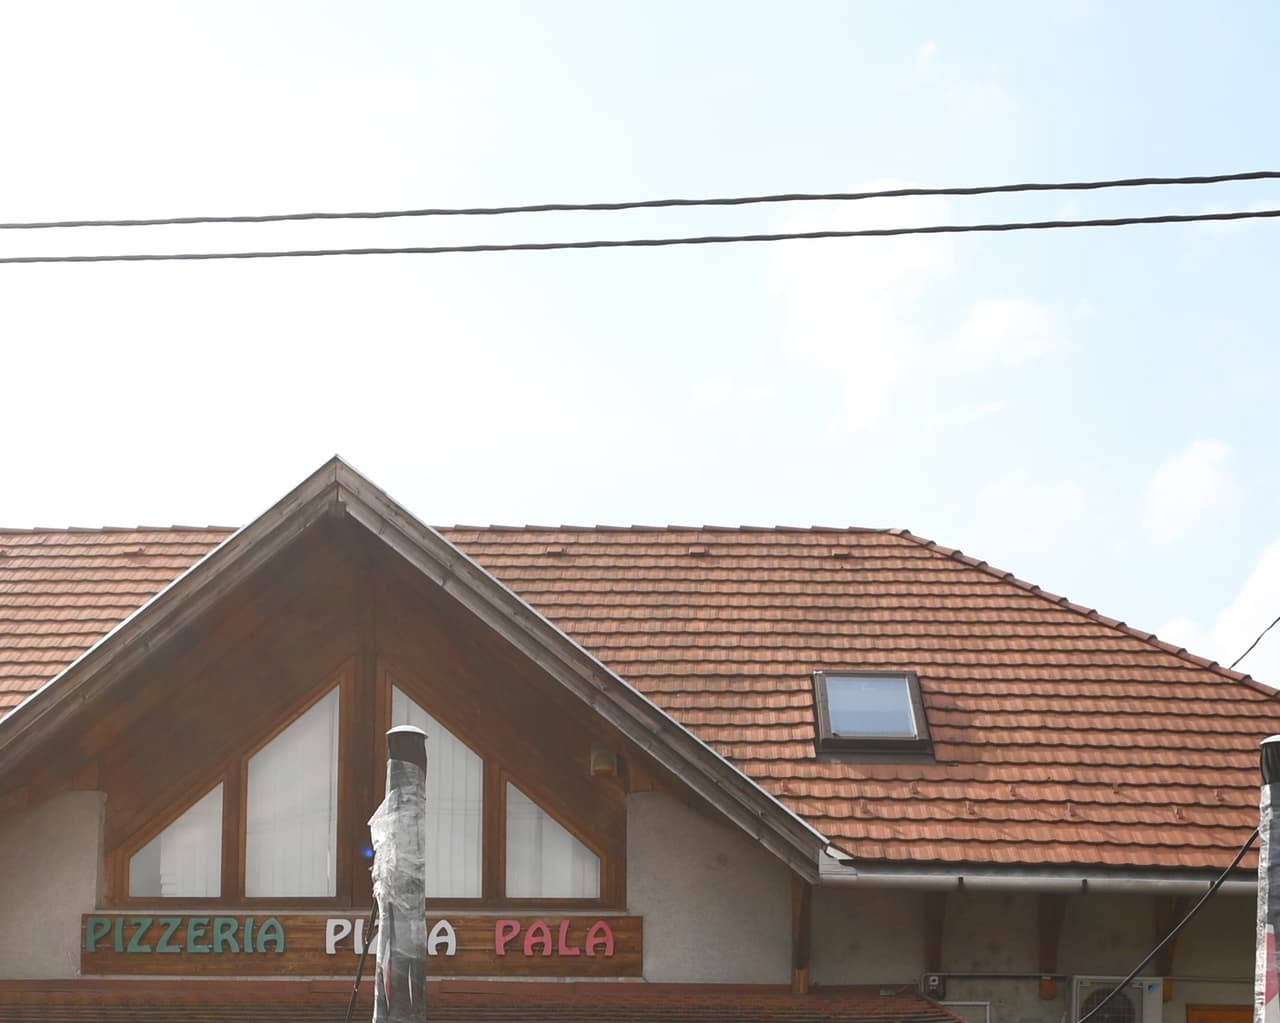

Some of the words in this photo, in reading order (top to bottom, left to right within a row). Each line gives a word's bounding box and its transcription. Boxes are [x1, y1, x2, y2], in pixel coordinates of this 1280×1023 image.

[86, 917, 287, 954] PIZZERIA
[325, 918, 457, 956] PIA
[494, 919, 616, 957] PALA
